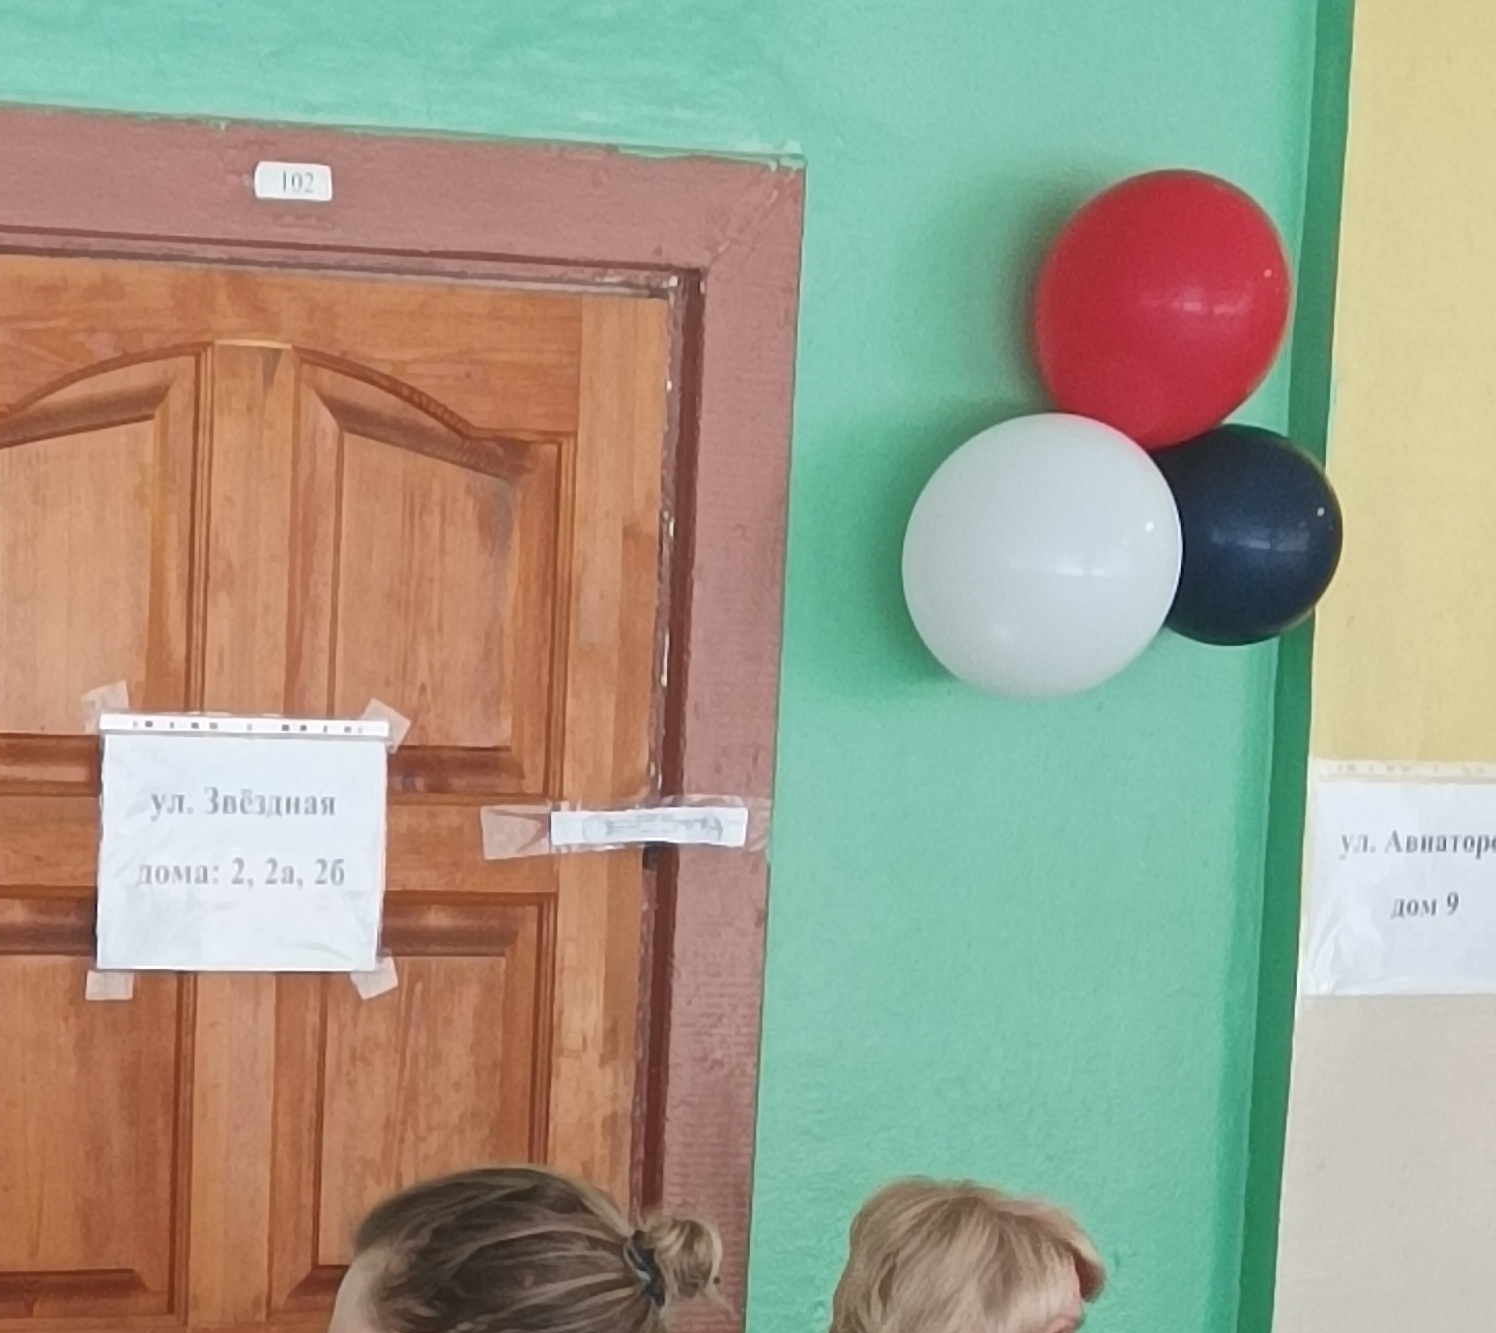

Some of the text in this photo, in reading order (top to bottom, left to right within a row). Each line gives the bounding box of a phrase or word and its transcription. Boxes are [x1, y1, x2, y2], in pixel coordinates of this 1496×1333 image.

[282, 170, 314, 193] 102
[150, 786, 336, 822] ул. Звёздная
[1339, 834, 1376, 860] ул.
[135, 857, 345, 889] дома: 2, 2а, 2б
[1389, 891, 1460, 919] дом 9
